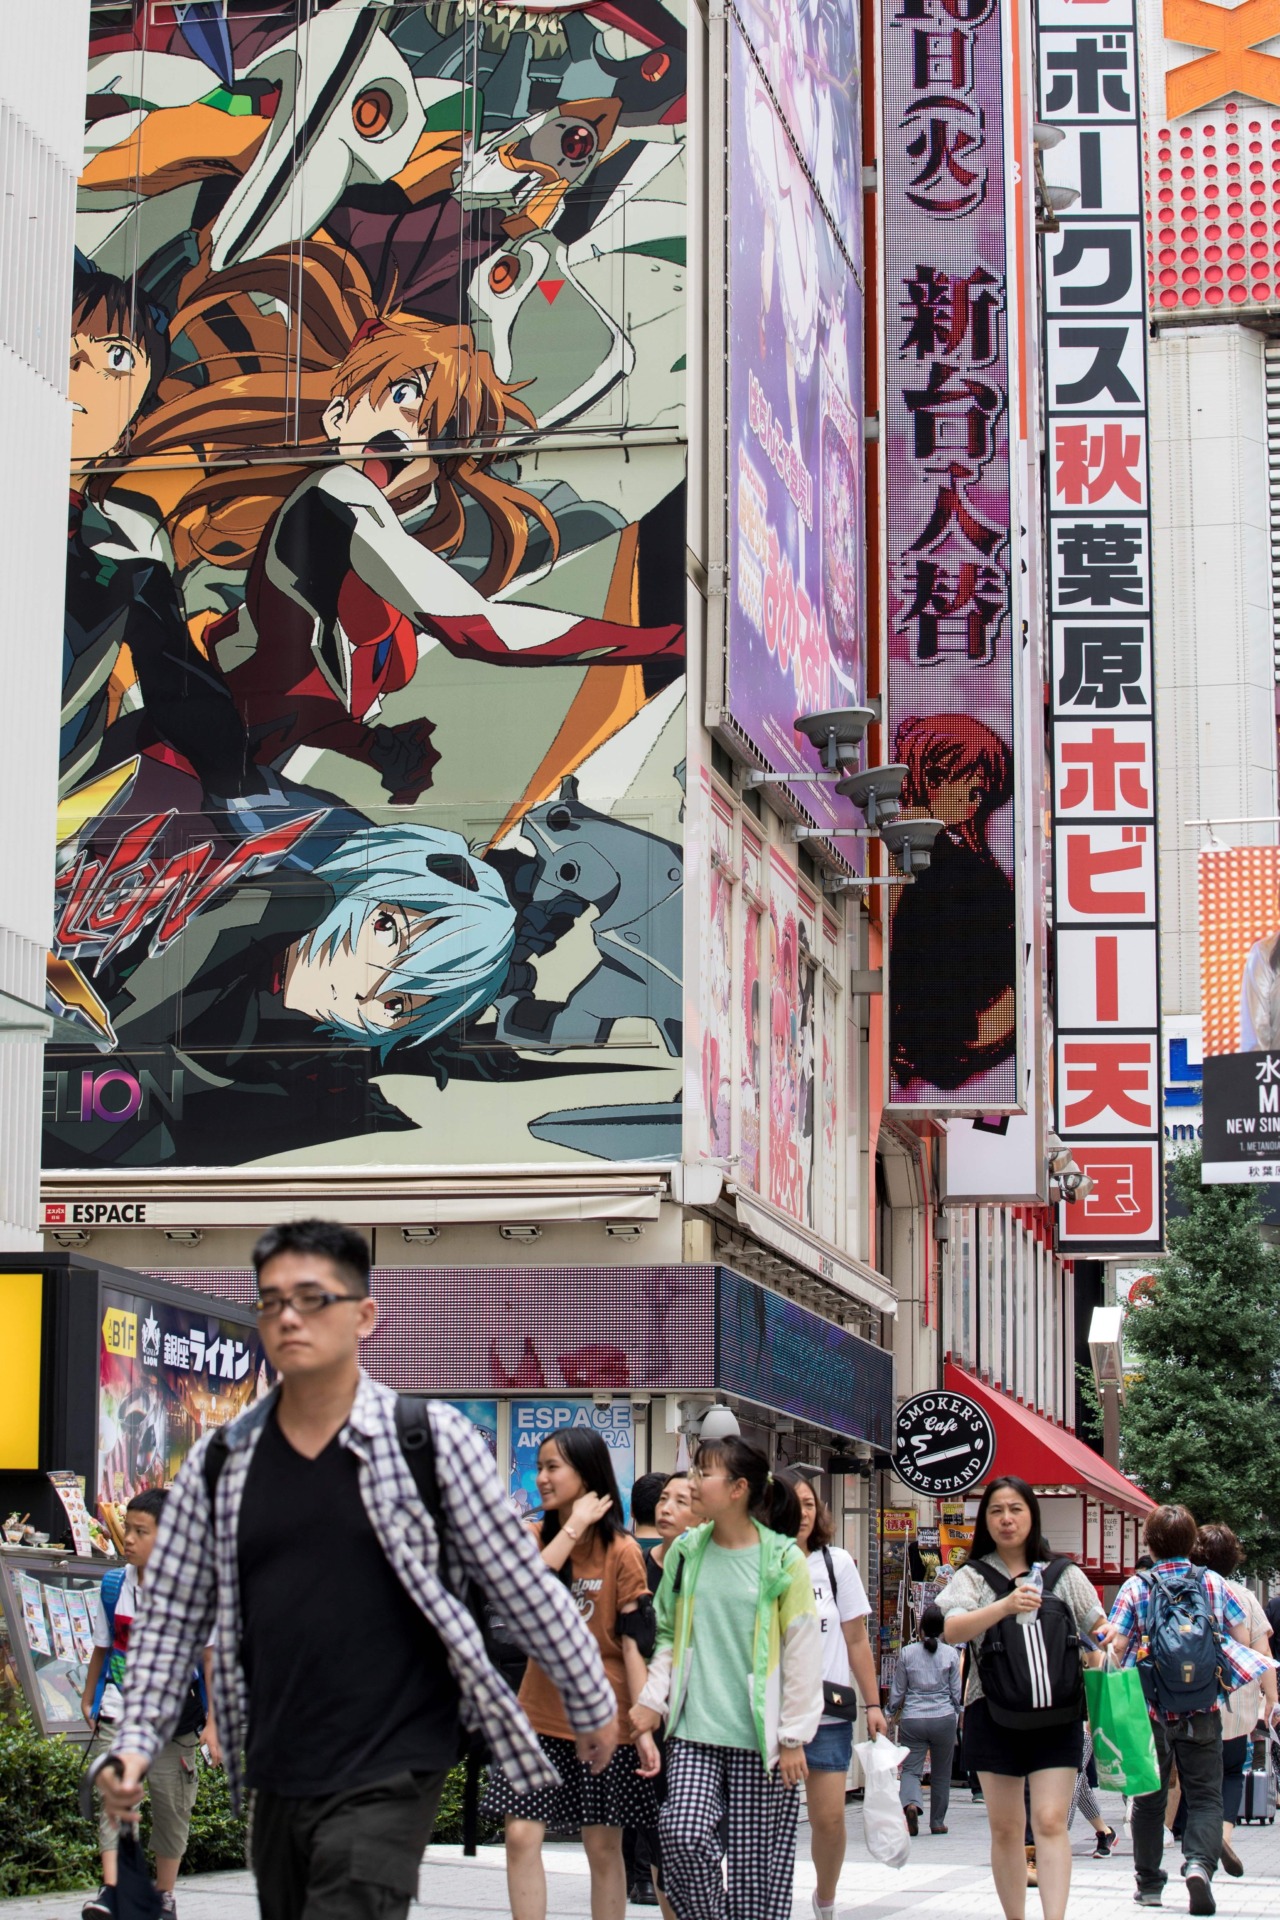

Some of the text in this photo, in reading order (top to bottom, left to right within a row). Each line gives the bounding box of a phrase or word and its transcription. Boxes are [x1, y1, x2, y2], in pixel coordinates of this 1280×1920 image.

[898, 265, 1005, 663] 新台入替
[1226, 1118, 1256, 1134] NEW
[72, 1204, 147, 1224] ESPACE
[112, 1317, 135, 1350] B1F
[143, 1355, 158, 1367] LION
[163, 1329, 250, 1380] 銀座ライオン
[517, 1406, 631, 1429] ESPACE
[899, 1397, 984, 1432] SMOKER'S
[923, 1416, 959, 1436] Cafe
[899, 1455, 981, 1490] VAPE STAND
